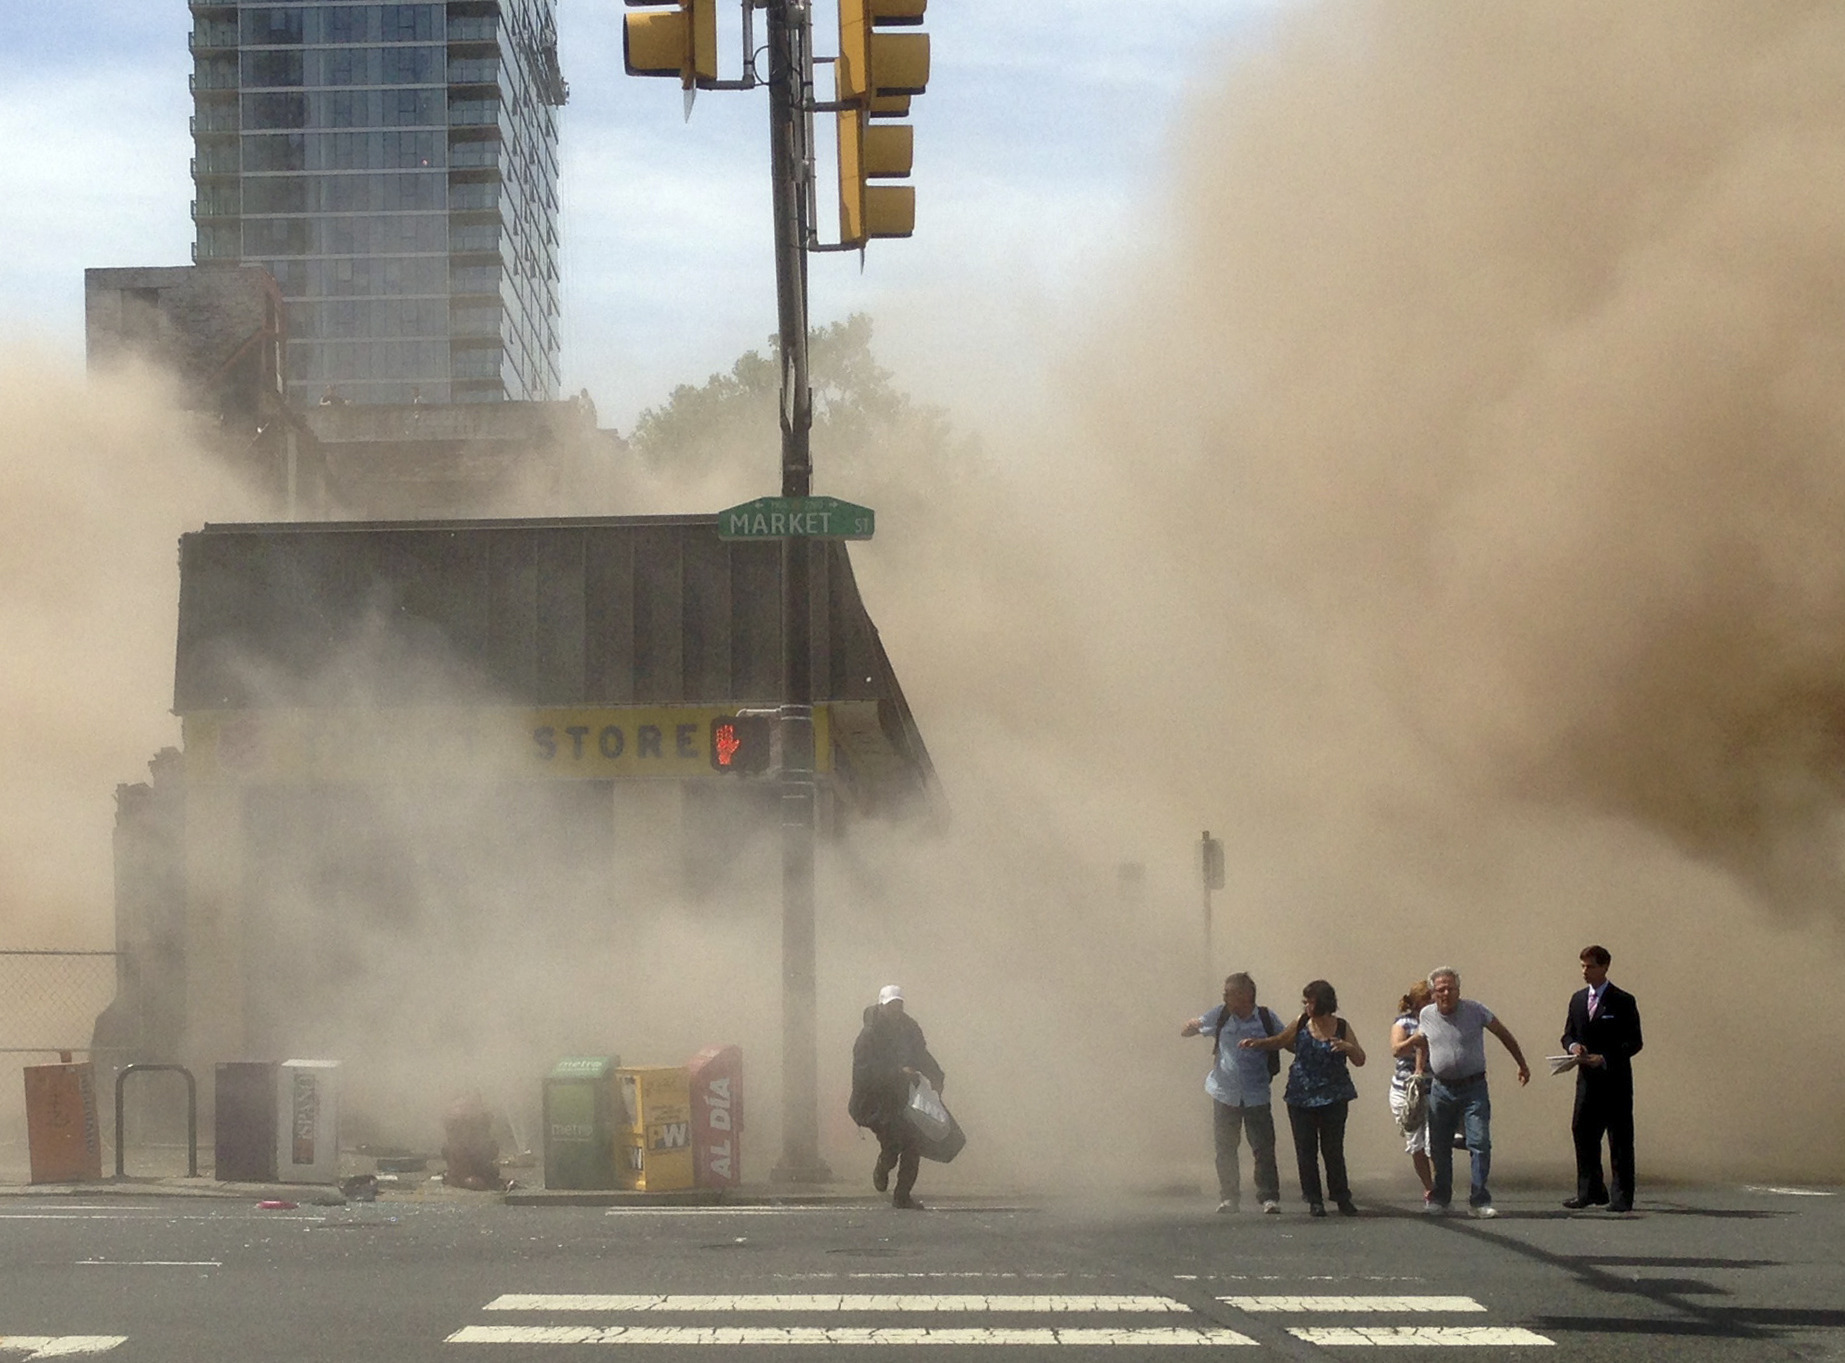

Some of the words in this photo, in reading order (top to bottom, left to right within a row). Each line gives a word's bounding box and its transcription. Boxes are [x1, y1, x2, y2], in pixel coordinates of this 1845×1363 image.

[729, 512, 832, 535] MARKET
[854, 517, 870, 534] ST
[532, 723, 699, 761] STORE
[551, 1123, 594, 1138] metro
[709, 1139, 732, 1180] AL
